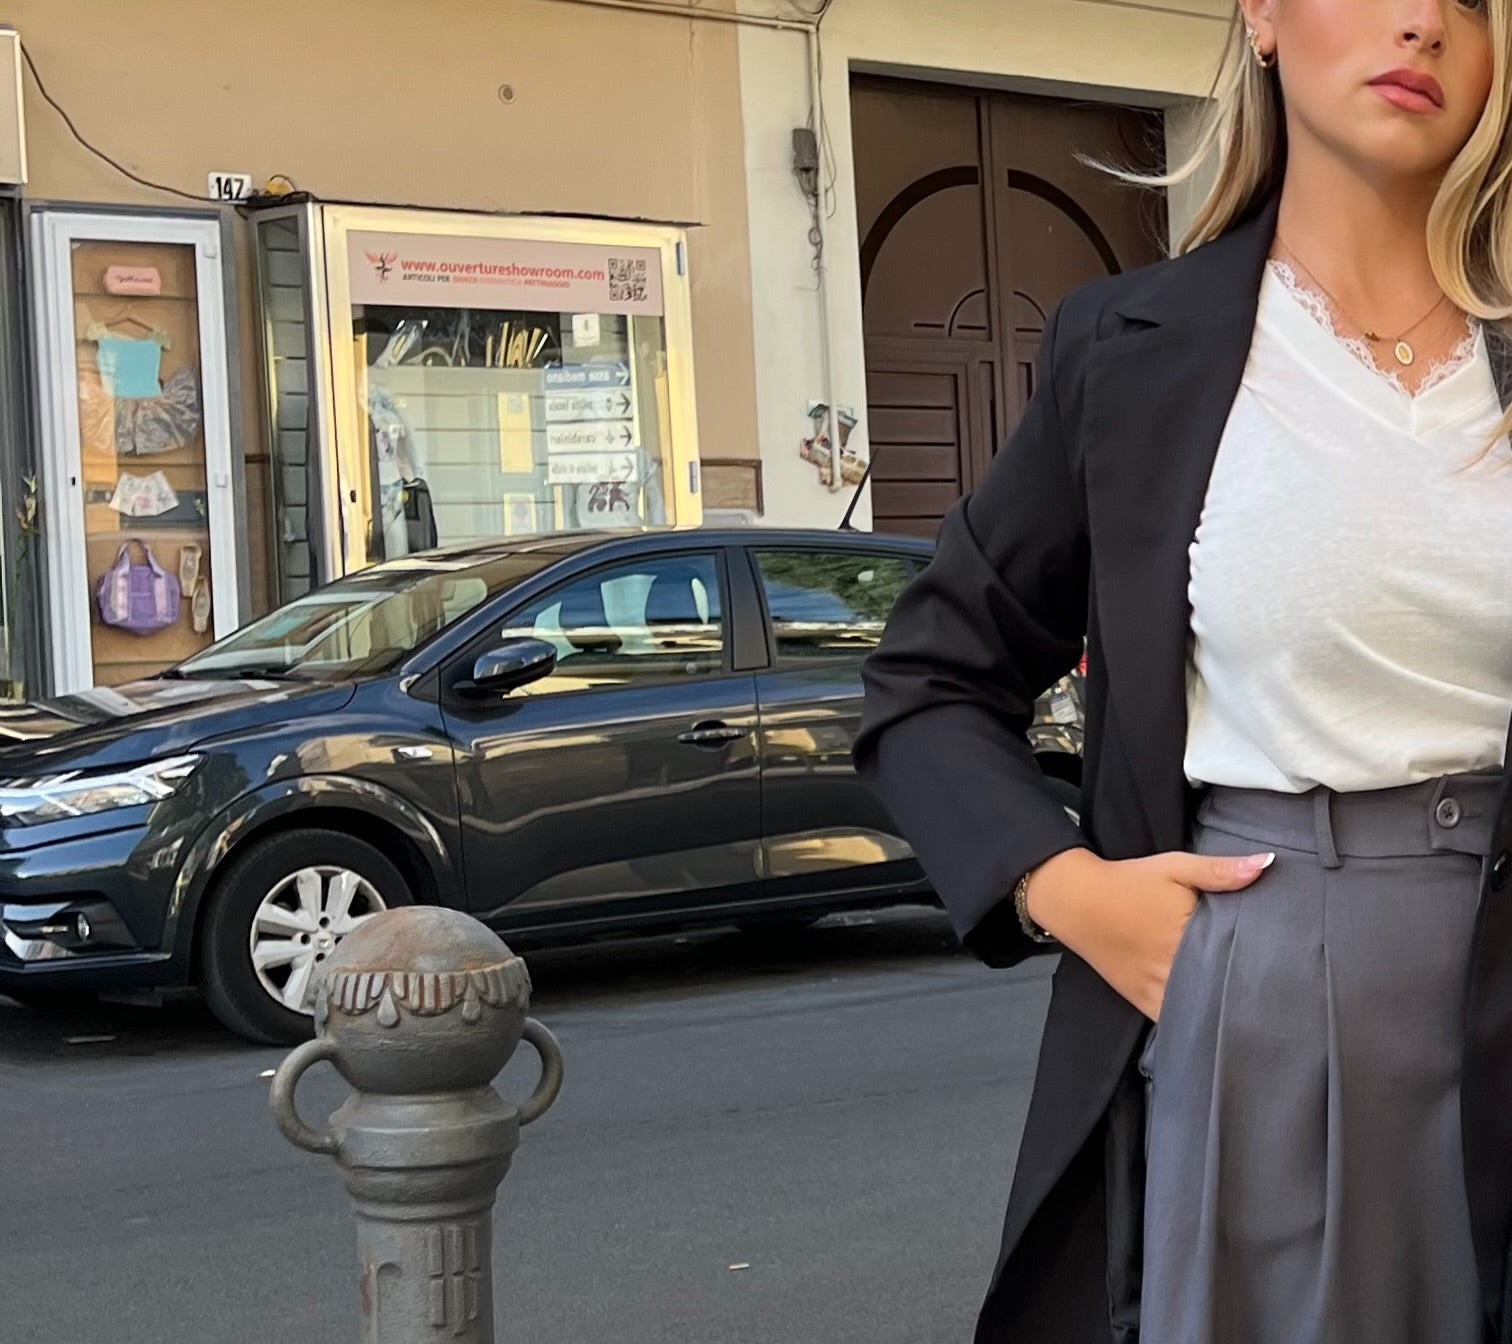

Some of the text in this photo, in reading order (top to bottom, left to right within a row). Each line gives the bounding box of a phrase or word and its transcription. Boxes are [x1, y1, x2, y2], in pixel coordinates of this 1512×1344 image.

[215, 176, 245, 201] 147
[401, 260, 605, 281] www.ouvertureshowroom.com
[437, 274, 450, 282] PER
